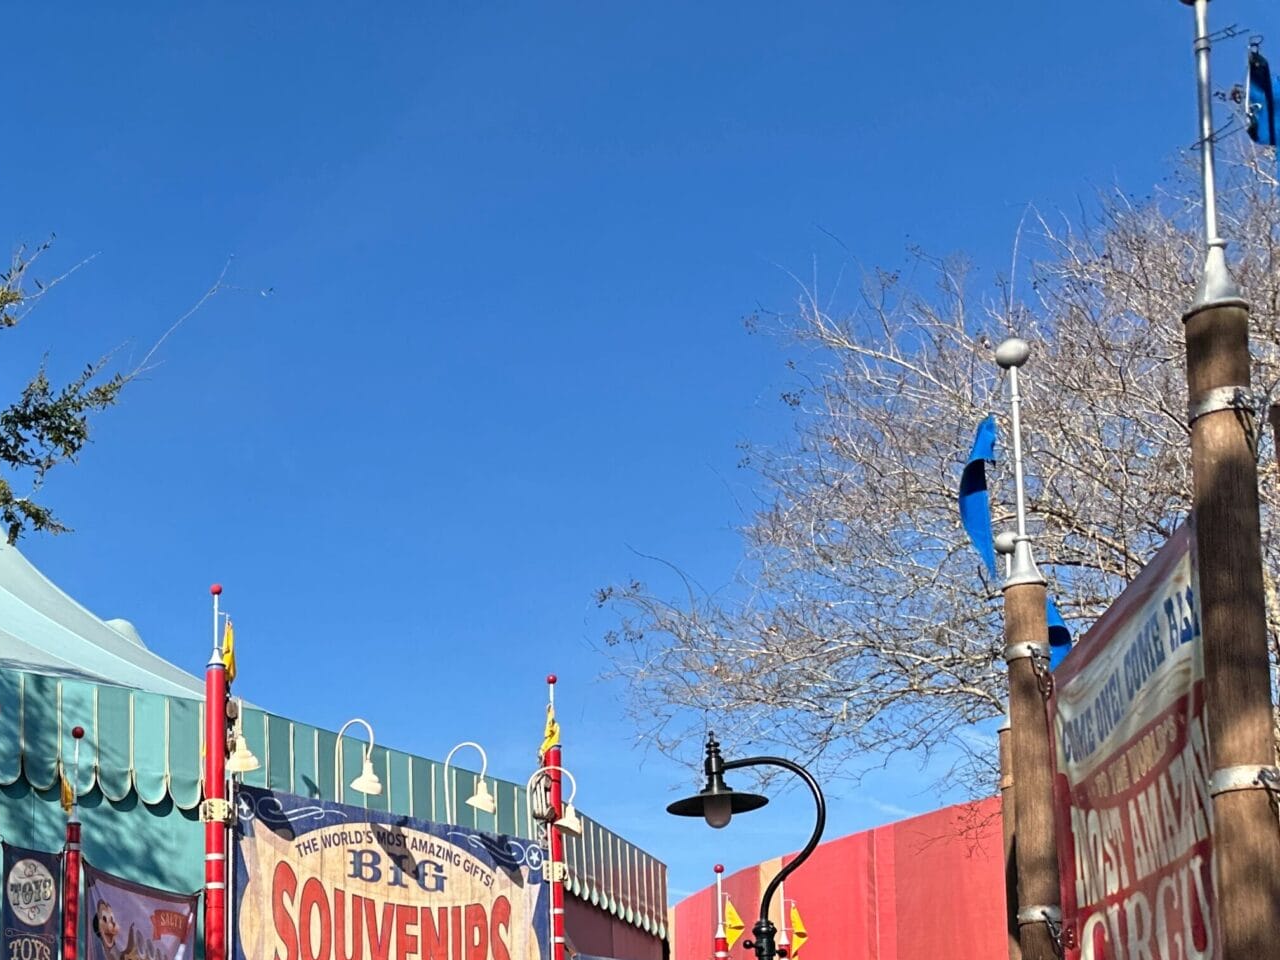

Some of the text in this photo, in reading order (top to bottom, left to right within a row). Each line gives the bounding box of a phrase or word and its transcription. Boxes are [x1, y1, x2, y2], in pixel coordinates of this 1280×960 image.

[1094, 668, 1125, 743] ONE!
[1123, 611, 1165, 703] COME
[295, 830, 496, 890] THE WORLD'S MOST AMAZING GIFTS!
[346, 848, 449, 894] BIG
[1070, 804, 1130, 909] MOST
[10, 878, 53, 906] TOYS
[160, 911, 184, 929] SALTY
